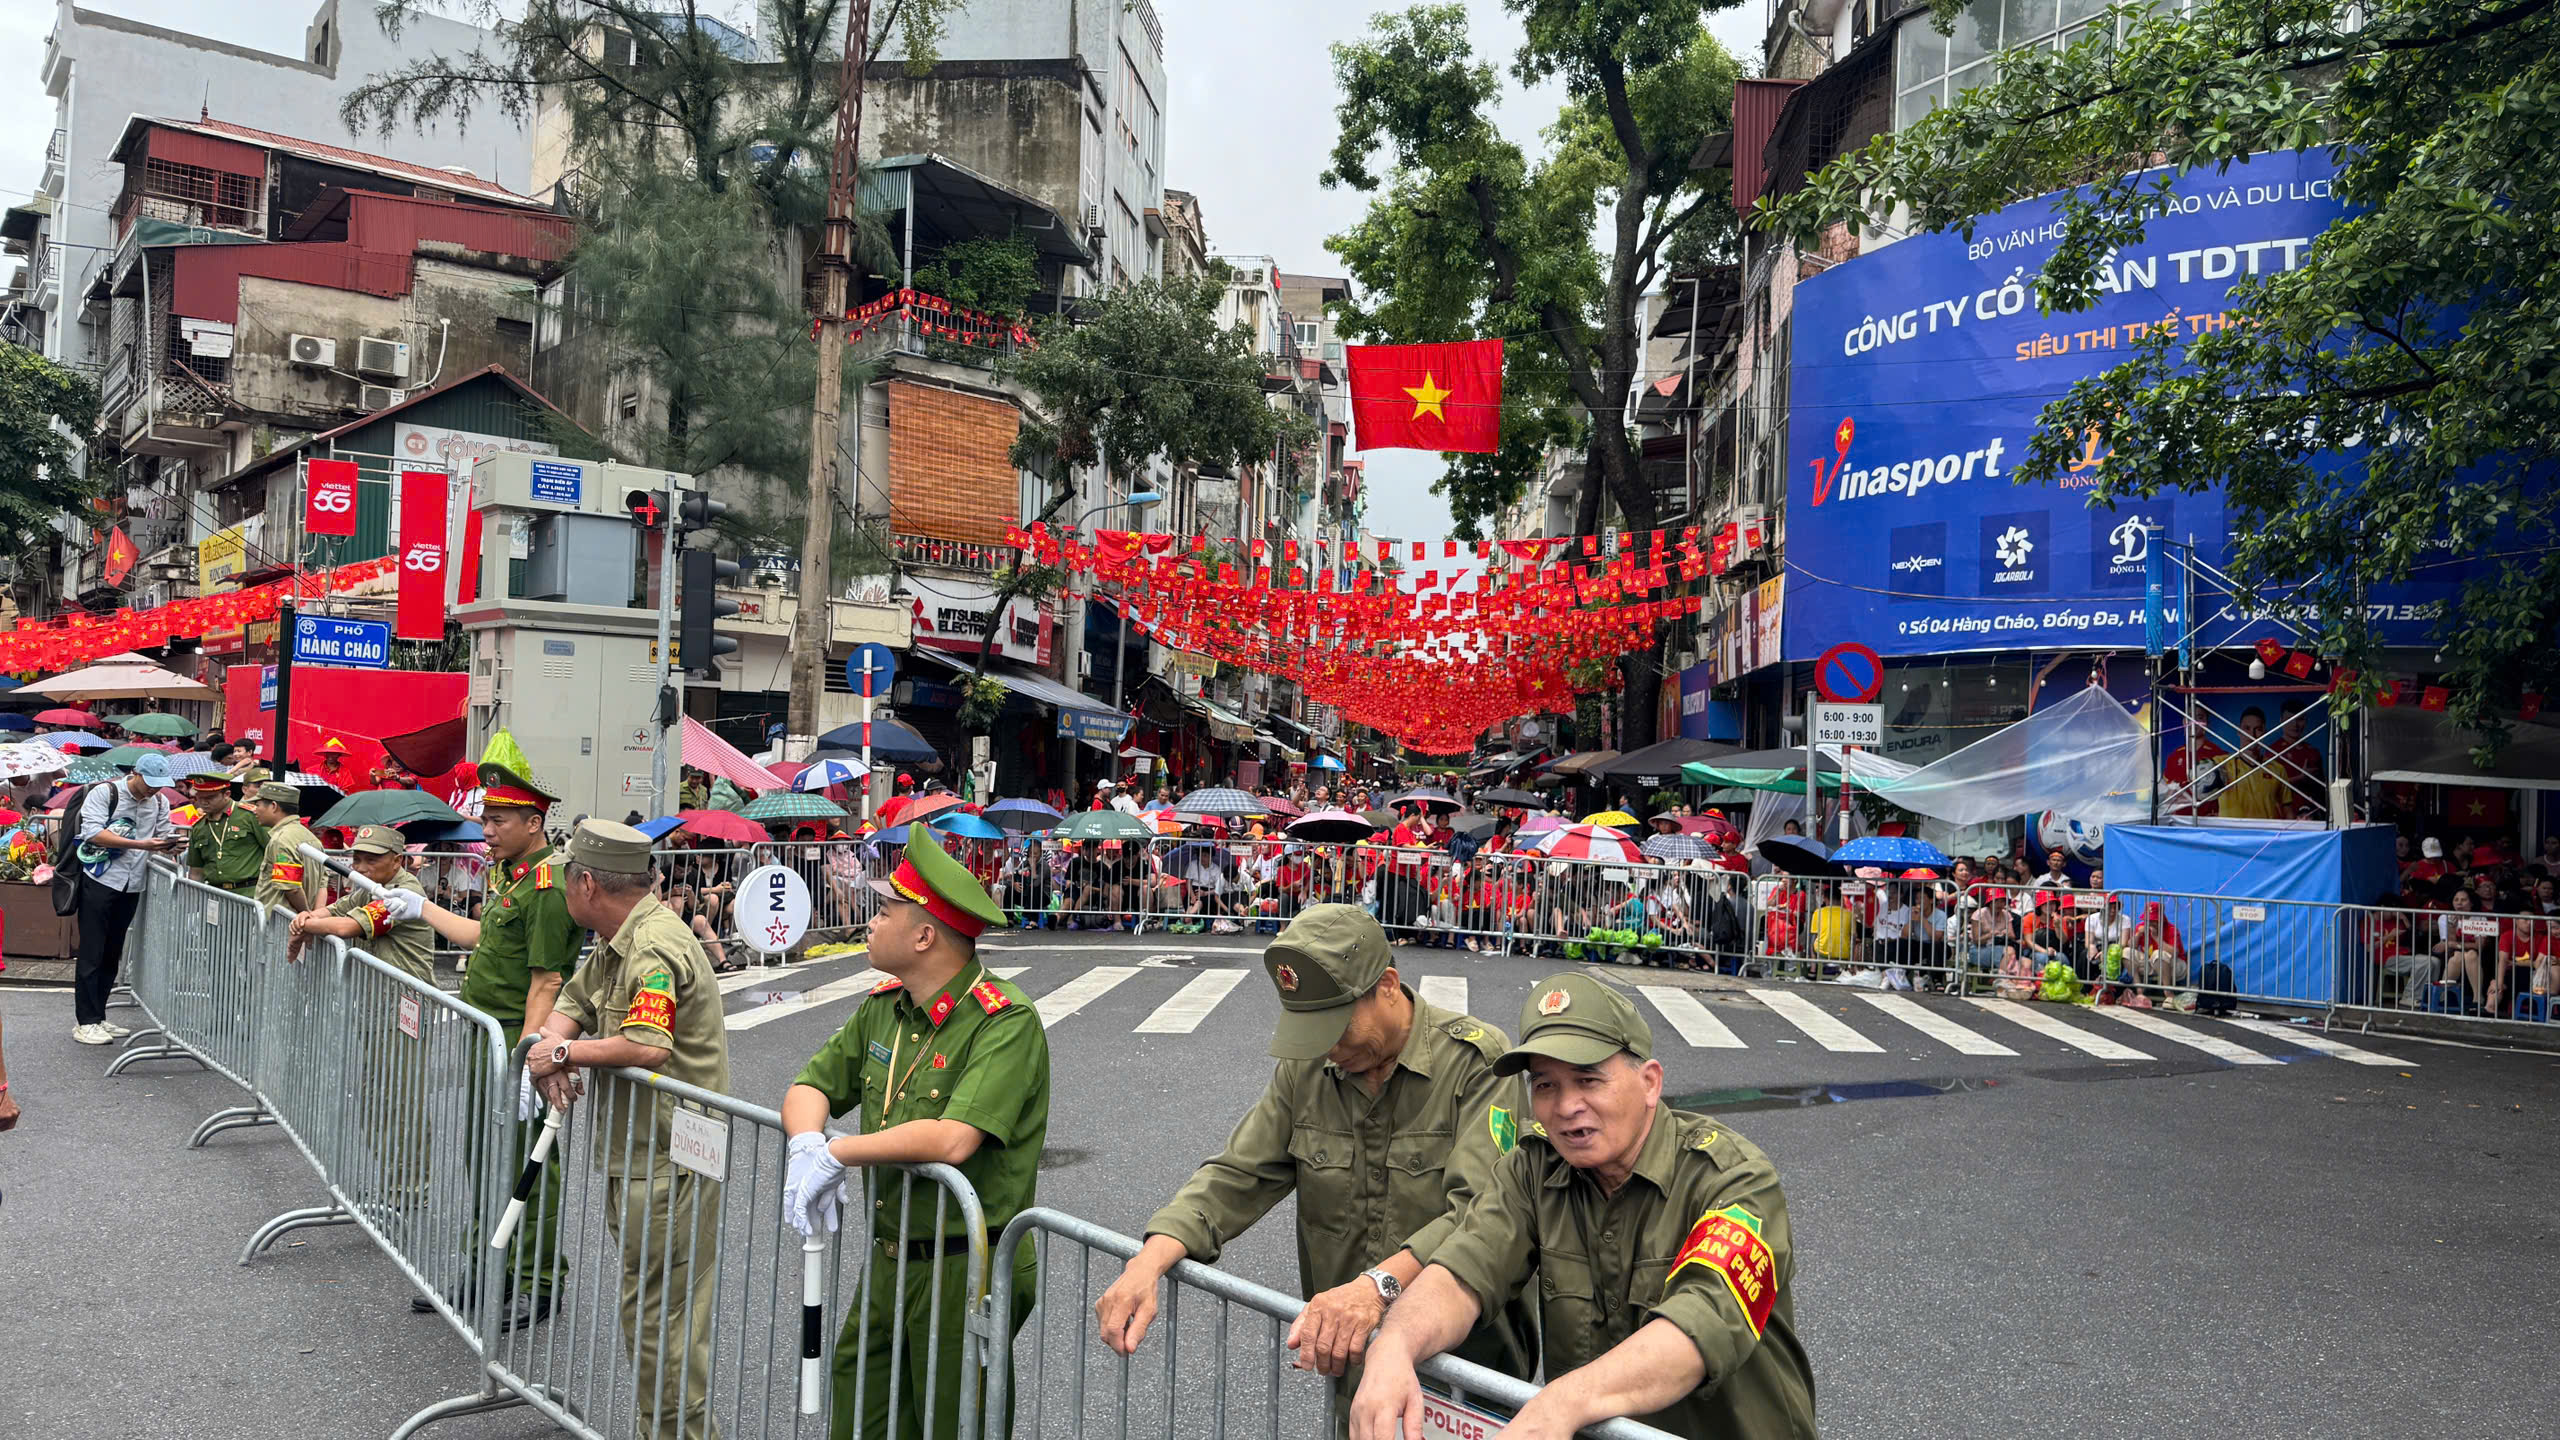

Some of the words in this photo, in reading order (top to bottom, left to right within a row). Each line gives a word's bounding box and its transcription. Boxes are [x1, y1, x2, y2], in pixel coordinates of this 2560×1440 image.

[1968, 236, 1993, 260] BỘ
[1996, 228, 2034, 253] VĂN
[2039, 220, 2070, 244] HÓ
[2207, 186, 2241, 209] VÀ
[2247, 184, 2283, 205] DU
[1844, 310, 1917, 356] CÔNG
[1923, 296, 1969, 333] TY
[1976, 266, 2025, 320] CỔ
[2168, 238, 2308, 284] TDTT
[2016, 333, 2070, 361] SIÊU
[2075, 327, 2116, 349] THỊ
[1809, 417, 2004, 506] Vinasport
[321, 482, 351, 491] viettel
[313, 490, 351, 513] 5G
[413, 542, 441, 551] viettel
[405, 550, 441, 572] 5G
[757, 557, 788, 569] TÂN
[1993, 570, 2033, 583] JOGARBOLA
[937, 607, 990, 623] MITSUBI
[1909, 616, 1931, 634] Số
[1931, 618, 1950, 633] 04
[1951, 614, 1992, 634] Hàng
[1994, 612, 2039, 631] Cháo,
[2043, 608, 2090, 630] Đống
[2093, 610, 2124, 627] Đa,
[334, 622, 364, 636] PHỐ
[938, 621, 987, 636] ELECTRI
[301, 634, 340, 657] HÀNG
[344, 636, 381, 660] CHÁO
[1824, 712, 1844, 722] 6:00
[1853, 713, 1873, 723] 9:00
[245, 728, 263, 740] viettel
[1819, 730, 1845, 740] 16:00
[1887, 734, 1942, 751] ENDURA
[770, 872, 786, 912] MB
[650, 997, 668, 1012] VỆ
[641, 1010, 671, 1027] PHỐ
[1749, 1244, 1769, 1277] VỆ
[1730, 1253, 1763, 1303] PHỐ
[1424, 1405, 1484, 1440] POLICE
